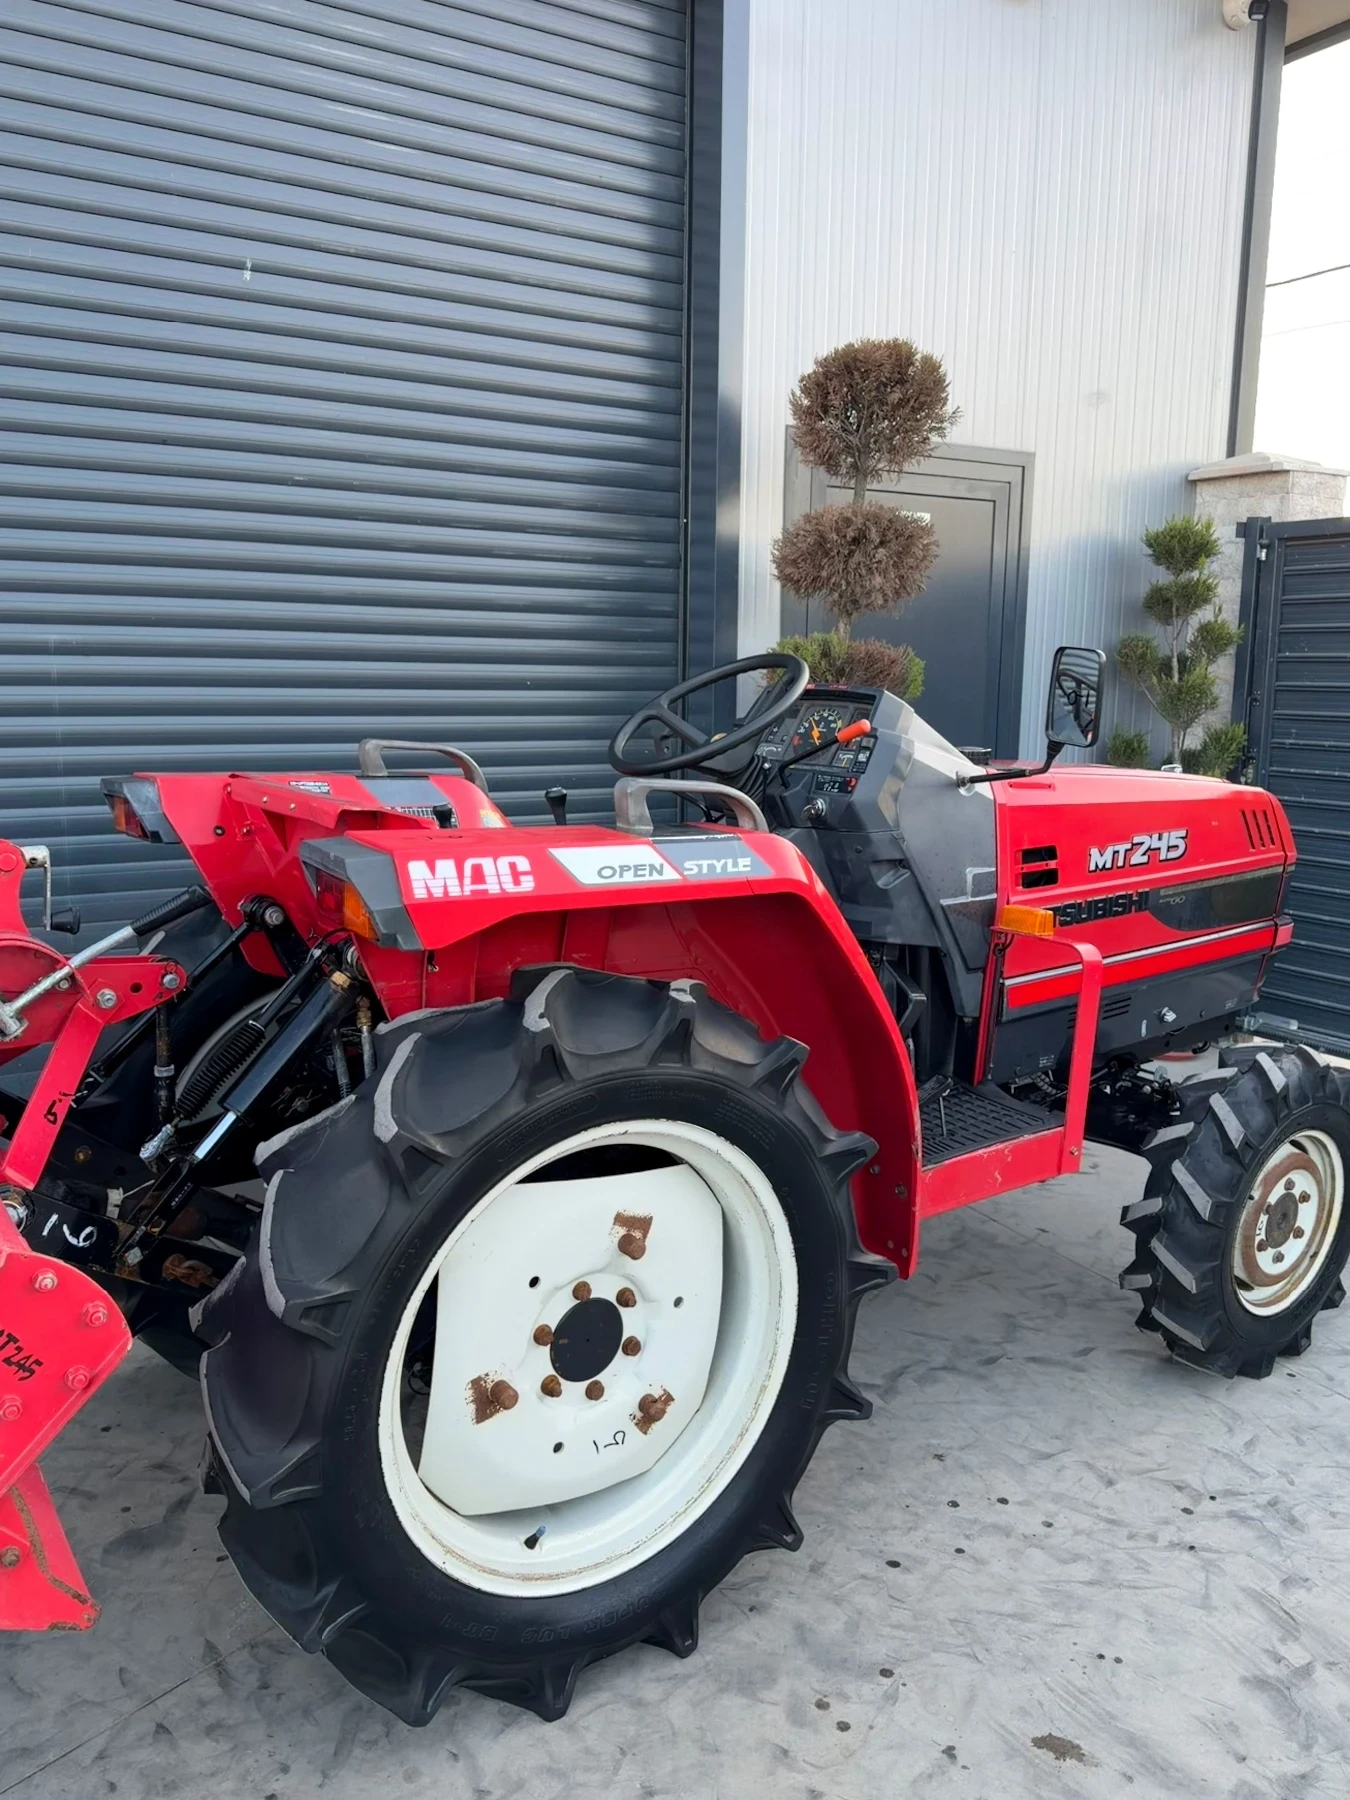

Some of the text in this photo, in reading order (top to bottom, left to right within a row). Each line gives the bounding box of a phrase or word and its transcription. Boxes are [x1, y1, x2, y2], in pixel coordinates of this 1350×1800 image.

[1088, 829, 1188, 873] MT245
[407, 855, 751, 899] MAC OPEN STYLE
